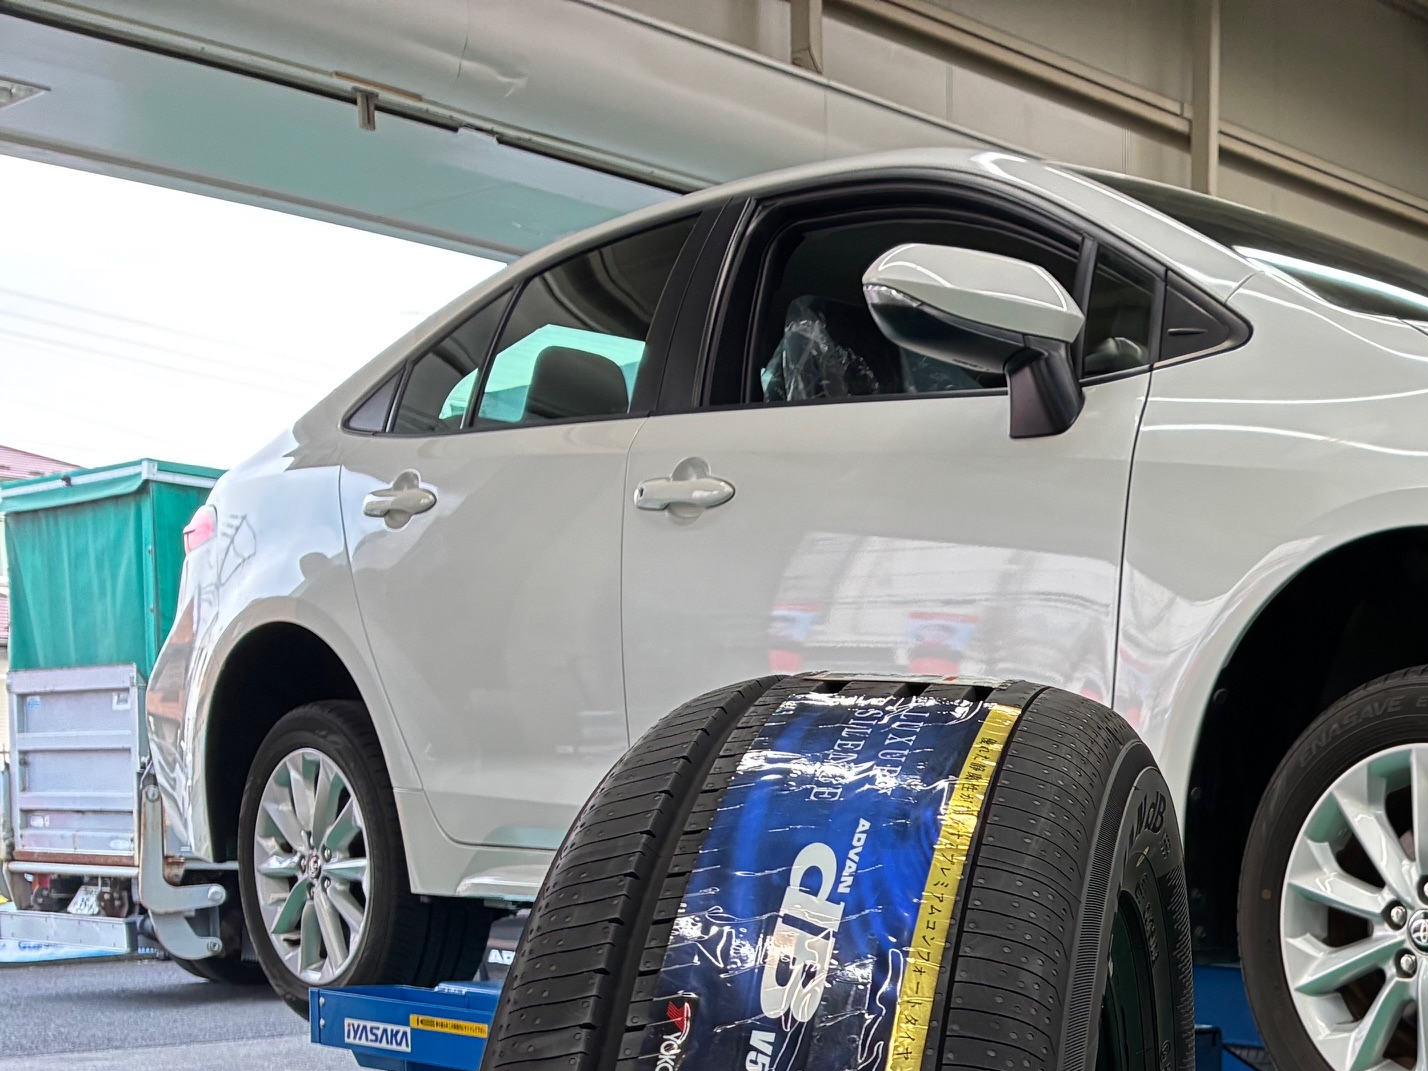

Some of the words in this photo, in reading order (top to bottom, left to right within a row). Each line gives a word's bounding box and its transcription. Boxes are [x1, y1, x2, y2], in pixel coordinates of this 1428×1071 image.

[837, 817, 872, 895] ADVAN
[760, 841, 846, 1023] dB
[347, 1021, 410, 1049] IYASAKA
